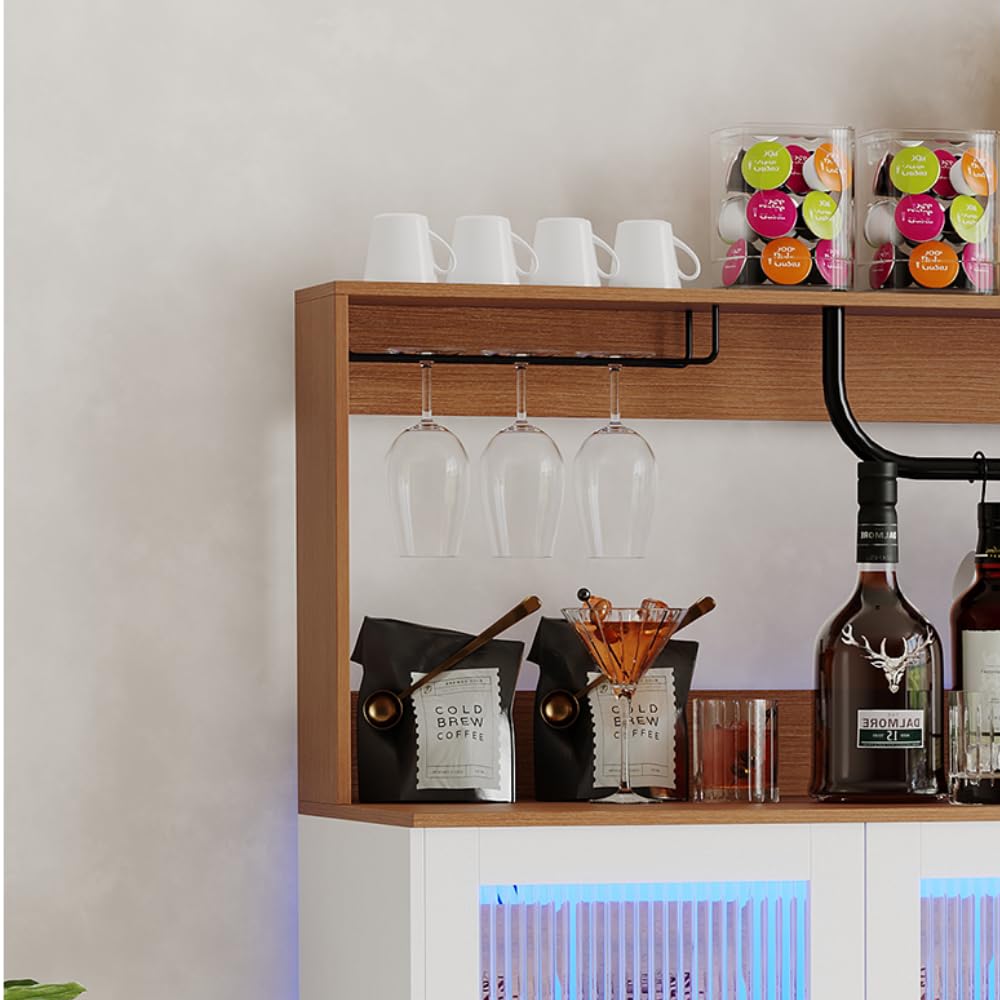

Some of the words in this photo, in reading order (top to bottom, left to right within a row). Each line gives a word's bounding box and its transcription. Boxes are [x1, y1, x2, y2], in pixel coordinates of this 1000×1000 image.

[435, 704, 483, 715] COLD
[437, 717, 484, 728] BREW
[437, 730, 485, 741] COFFEE
[613, 729, 660, 741] CFFEE
